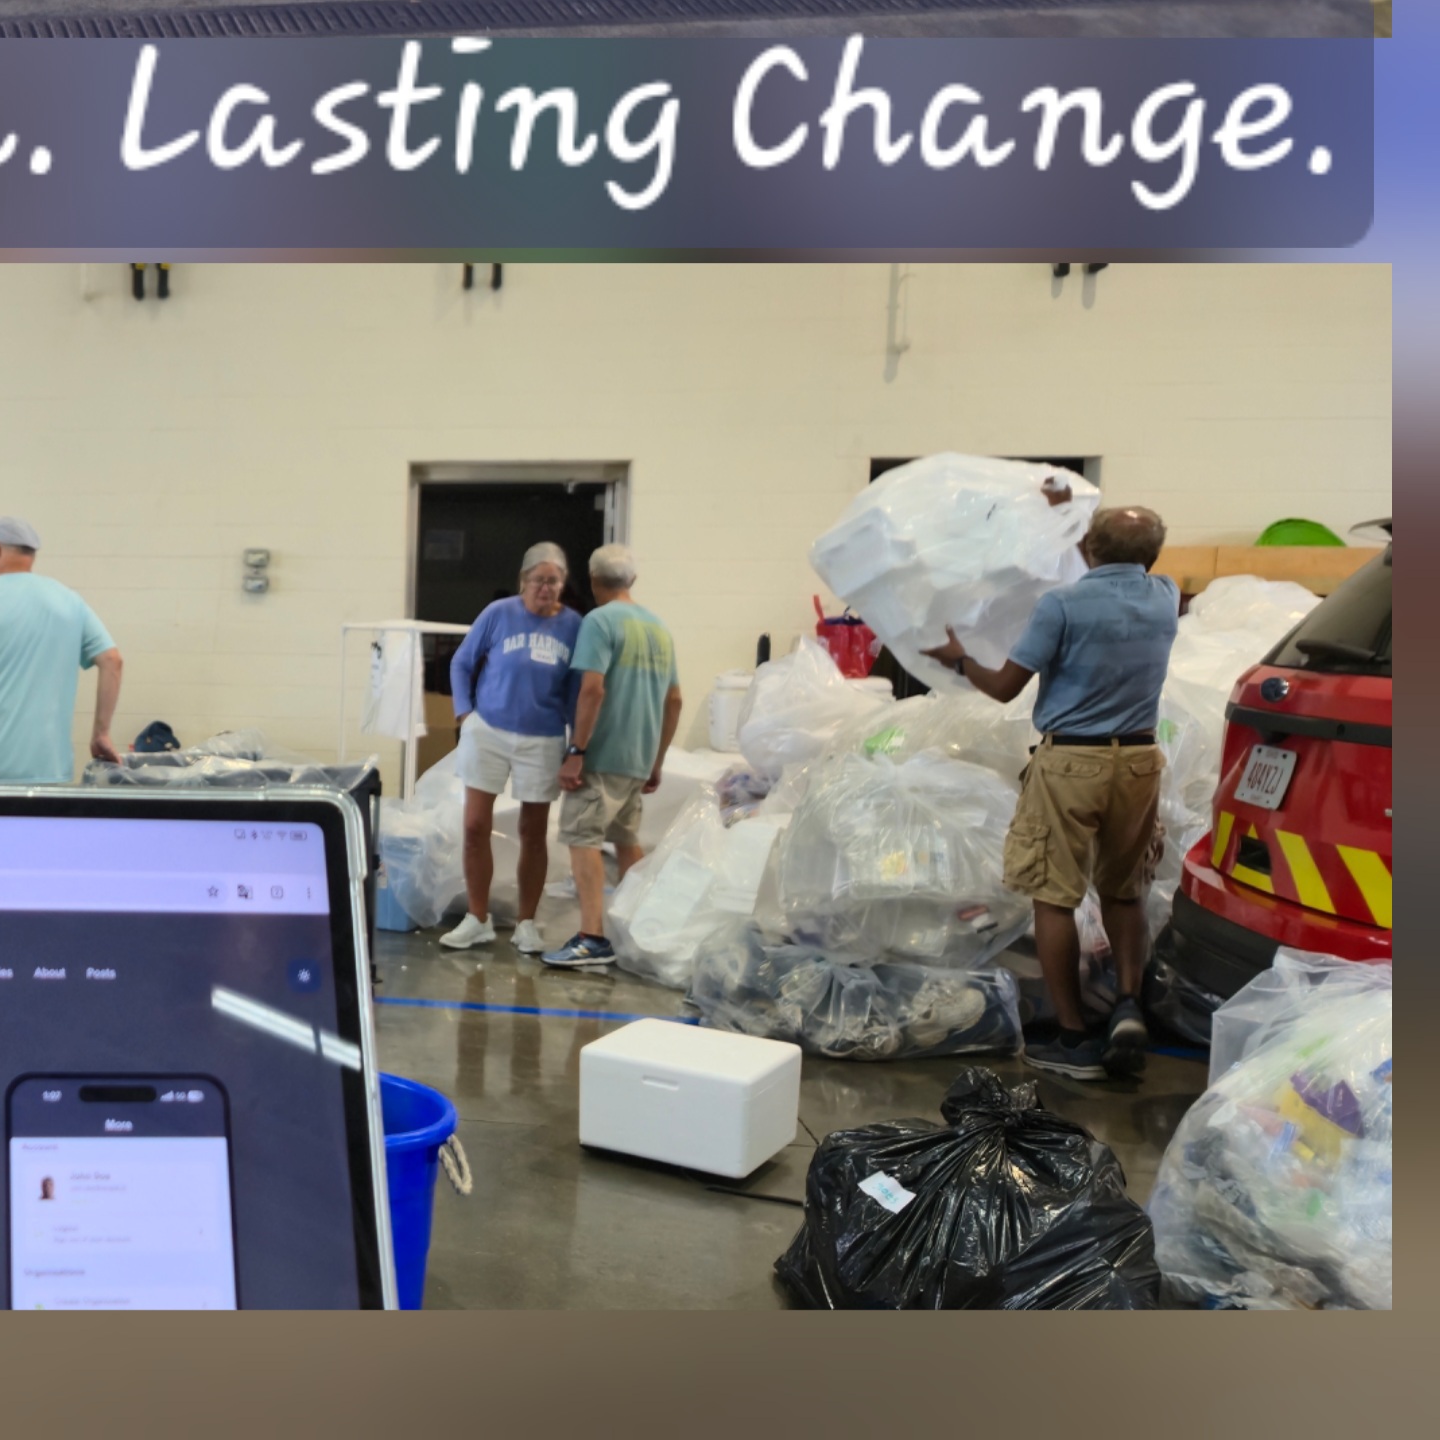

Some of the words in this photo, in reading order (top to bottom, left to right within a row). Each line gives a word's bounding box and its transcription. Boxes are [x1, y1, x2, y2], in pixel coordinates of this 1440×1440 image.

[33, 966, 66, 979] About
[86, 967, 117, 980] Posts
[104, 1118, 133, 1131] More
